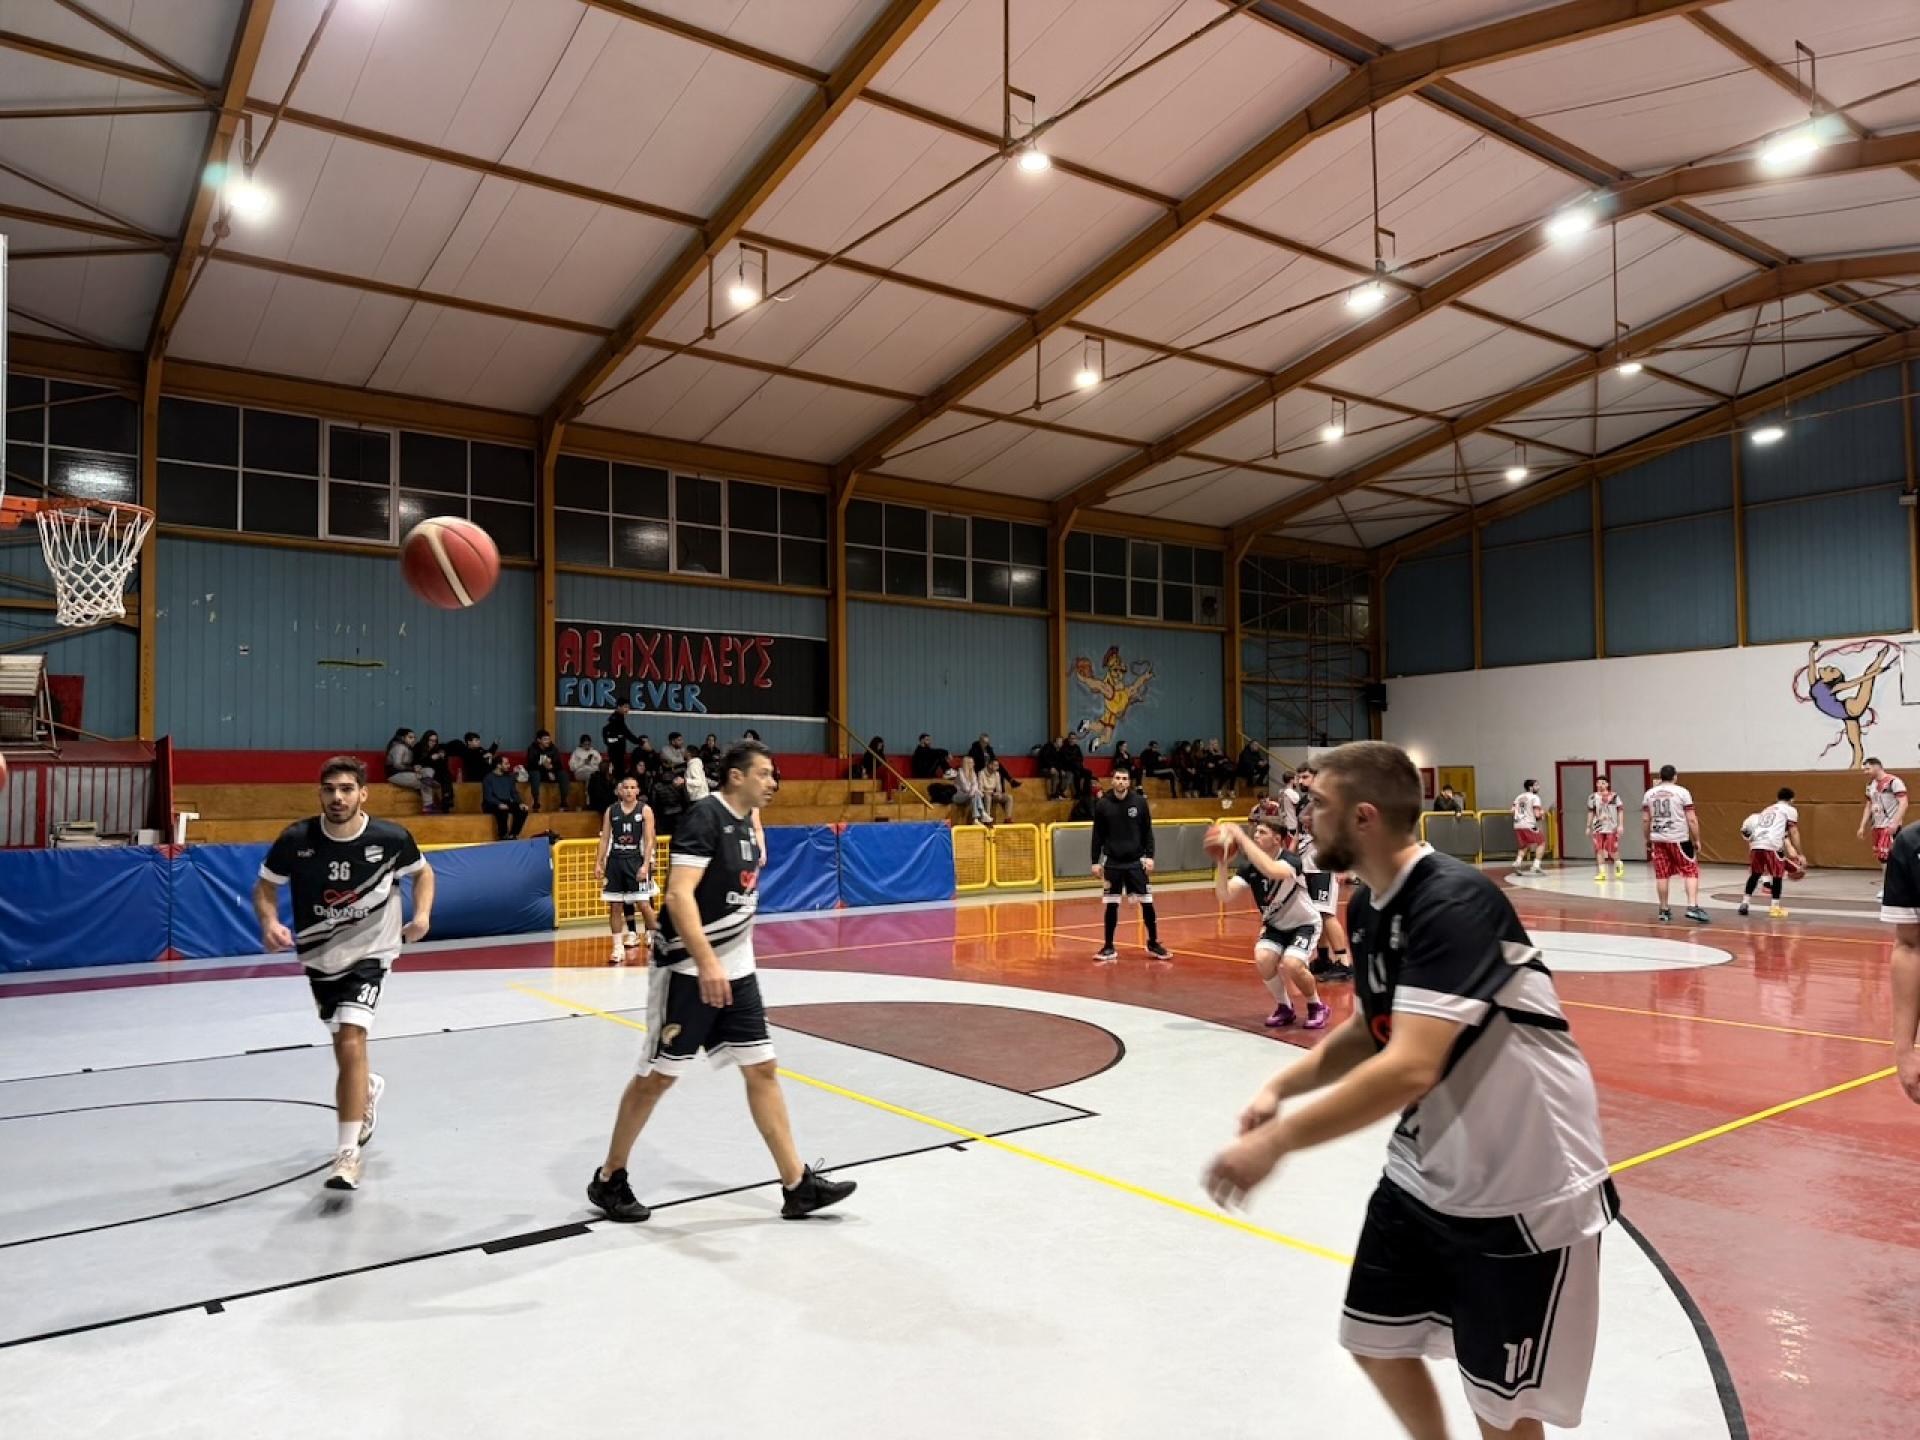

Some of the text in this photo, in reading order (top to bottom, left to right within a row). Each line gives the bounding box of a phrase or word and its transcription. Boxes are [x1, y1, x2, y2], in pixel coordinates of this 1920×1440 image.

[558, 677, 708, 713] FOR EVER
[328, 861, 352, 880] 36
[1502, 1337, 1534, 1384] 10
